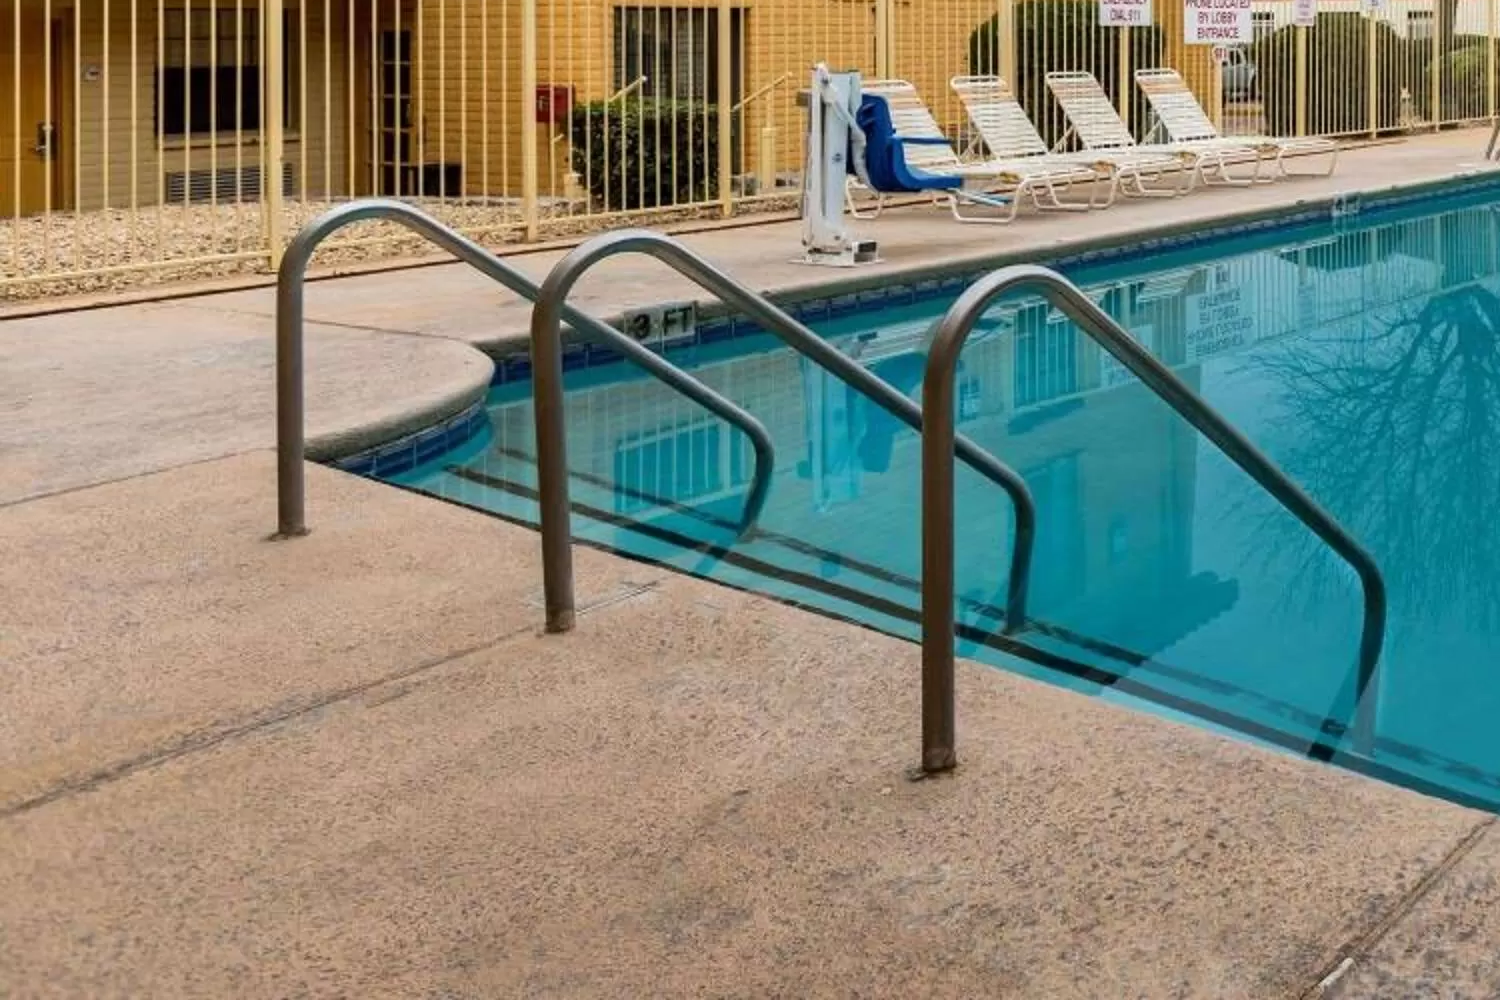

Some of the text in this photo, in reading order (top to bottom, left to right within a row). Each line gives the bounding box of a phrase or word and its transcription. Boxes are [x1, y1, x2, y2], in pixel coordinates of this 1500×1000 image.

[1109, 8, 1141, 21] DIAL 911
[1197, 11, 1238, 24] BY LOBBY
[1197, 27, 1240, 39] ENTRANCE
[633, 306, 693, 340] 3 FT
